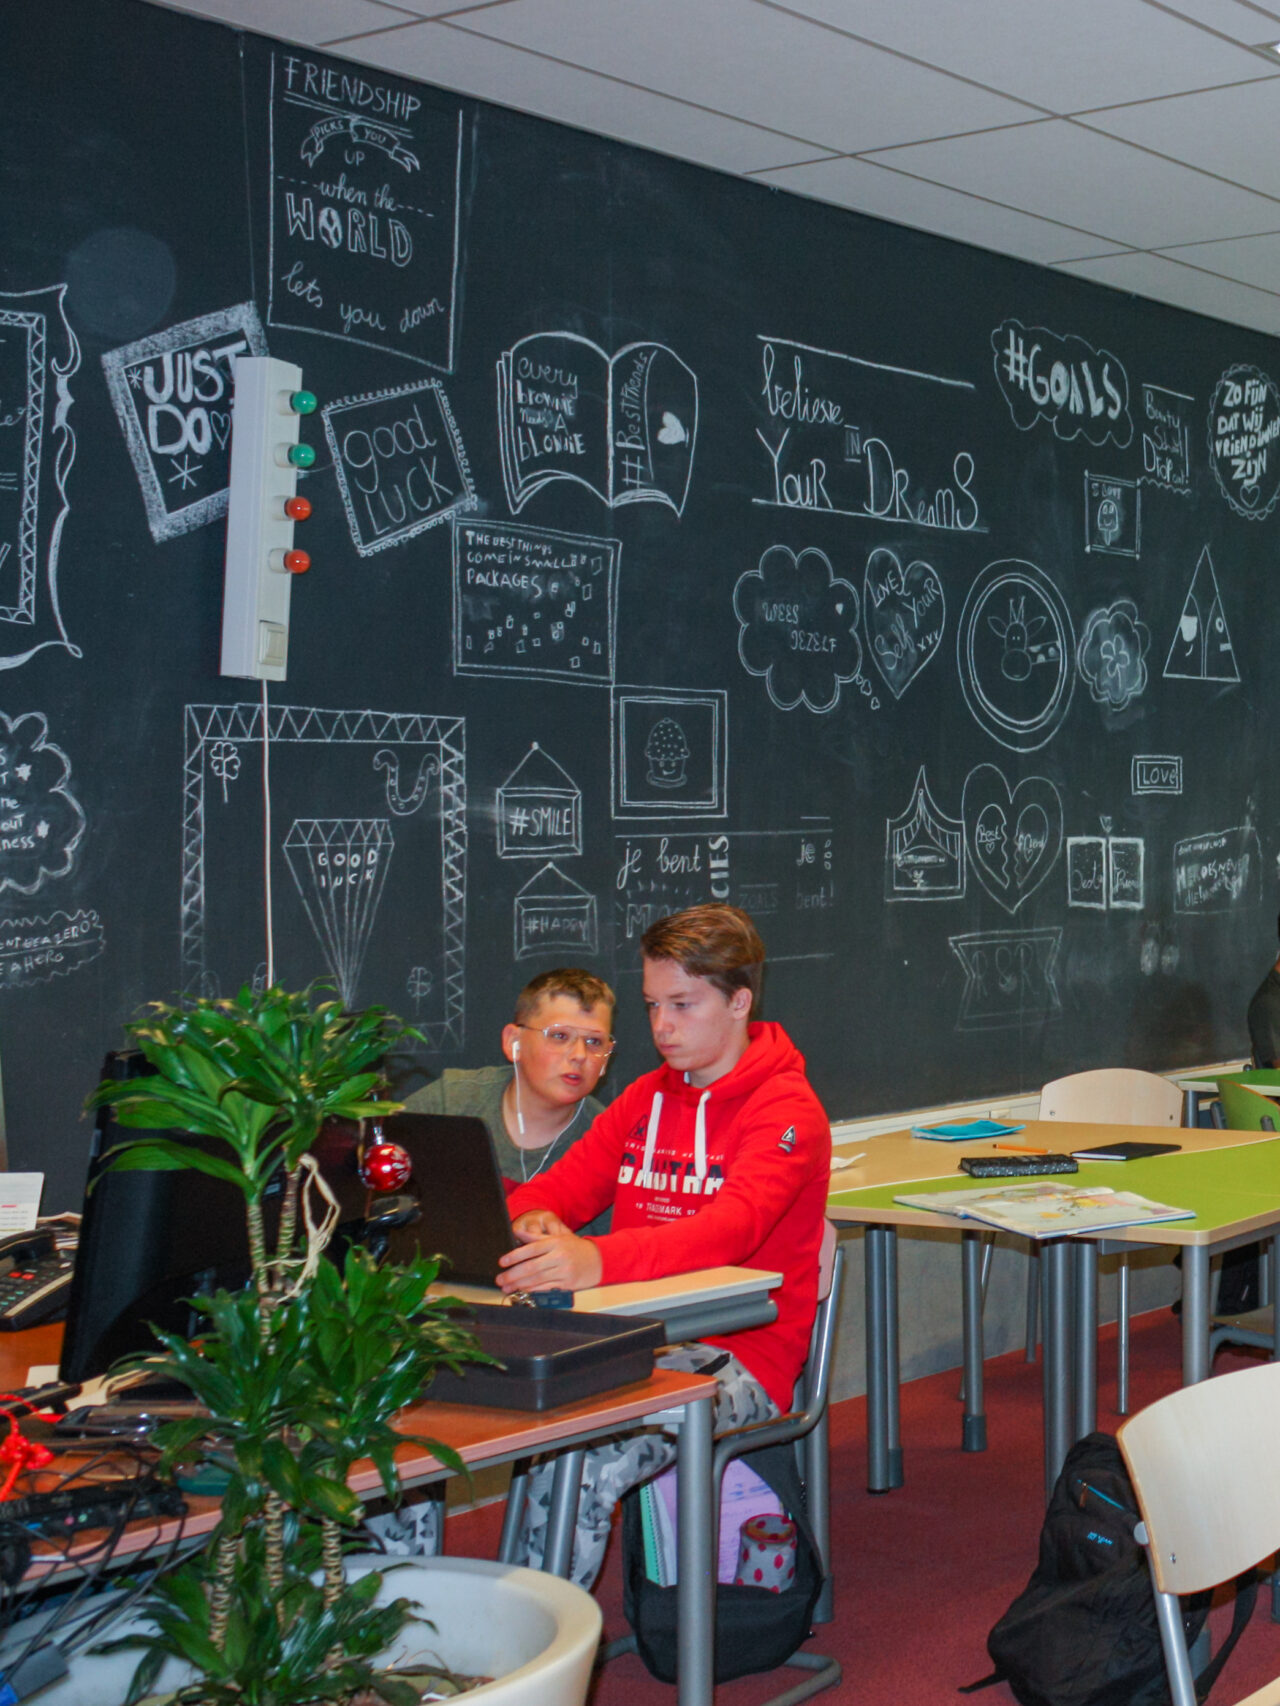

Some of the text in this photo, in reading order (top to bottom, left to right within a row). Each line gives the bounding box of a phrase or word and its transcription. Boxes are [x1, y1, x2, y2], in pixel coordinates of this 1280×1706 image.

[284, 56, 422, 122] FRIENDSHIP
[315, 121, 387, 144] PICKS YOU
[344, 150, 366, 167] UP
[320, 173, 397, 212] when the
[286, 193, 413, 268] WORLD
[281, 261, 446, 333] lets you down
[143, 341, 247, 404] JUST
[517, 357, 578, 400] every
[1223, 380, 1242, 408] ZO
[1217, 412, 1241, 435] DAT
[344, 404, 437, 492] good
[353, 456, 454, 536] LUCK
[465, 530, 490, 546] THE
[467, 552, 507, 564] COME
[466, 568, 543, 598] PACKAGES
[866, 569, 903, 608] LOVE
[762, 602, 800, 624] WEES
[790, 629, 838, 653] JEZELF
[509, 807, 572, 836] #SMILE
[317, 849, 378, 870] GOOD
[616, 841, 642, 890] je
[656, 837, 702, 874] bent
[522, 913, 588, 942] #HAPPY
